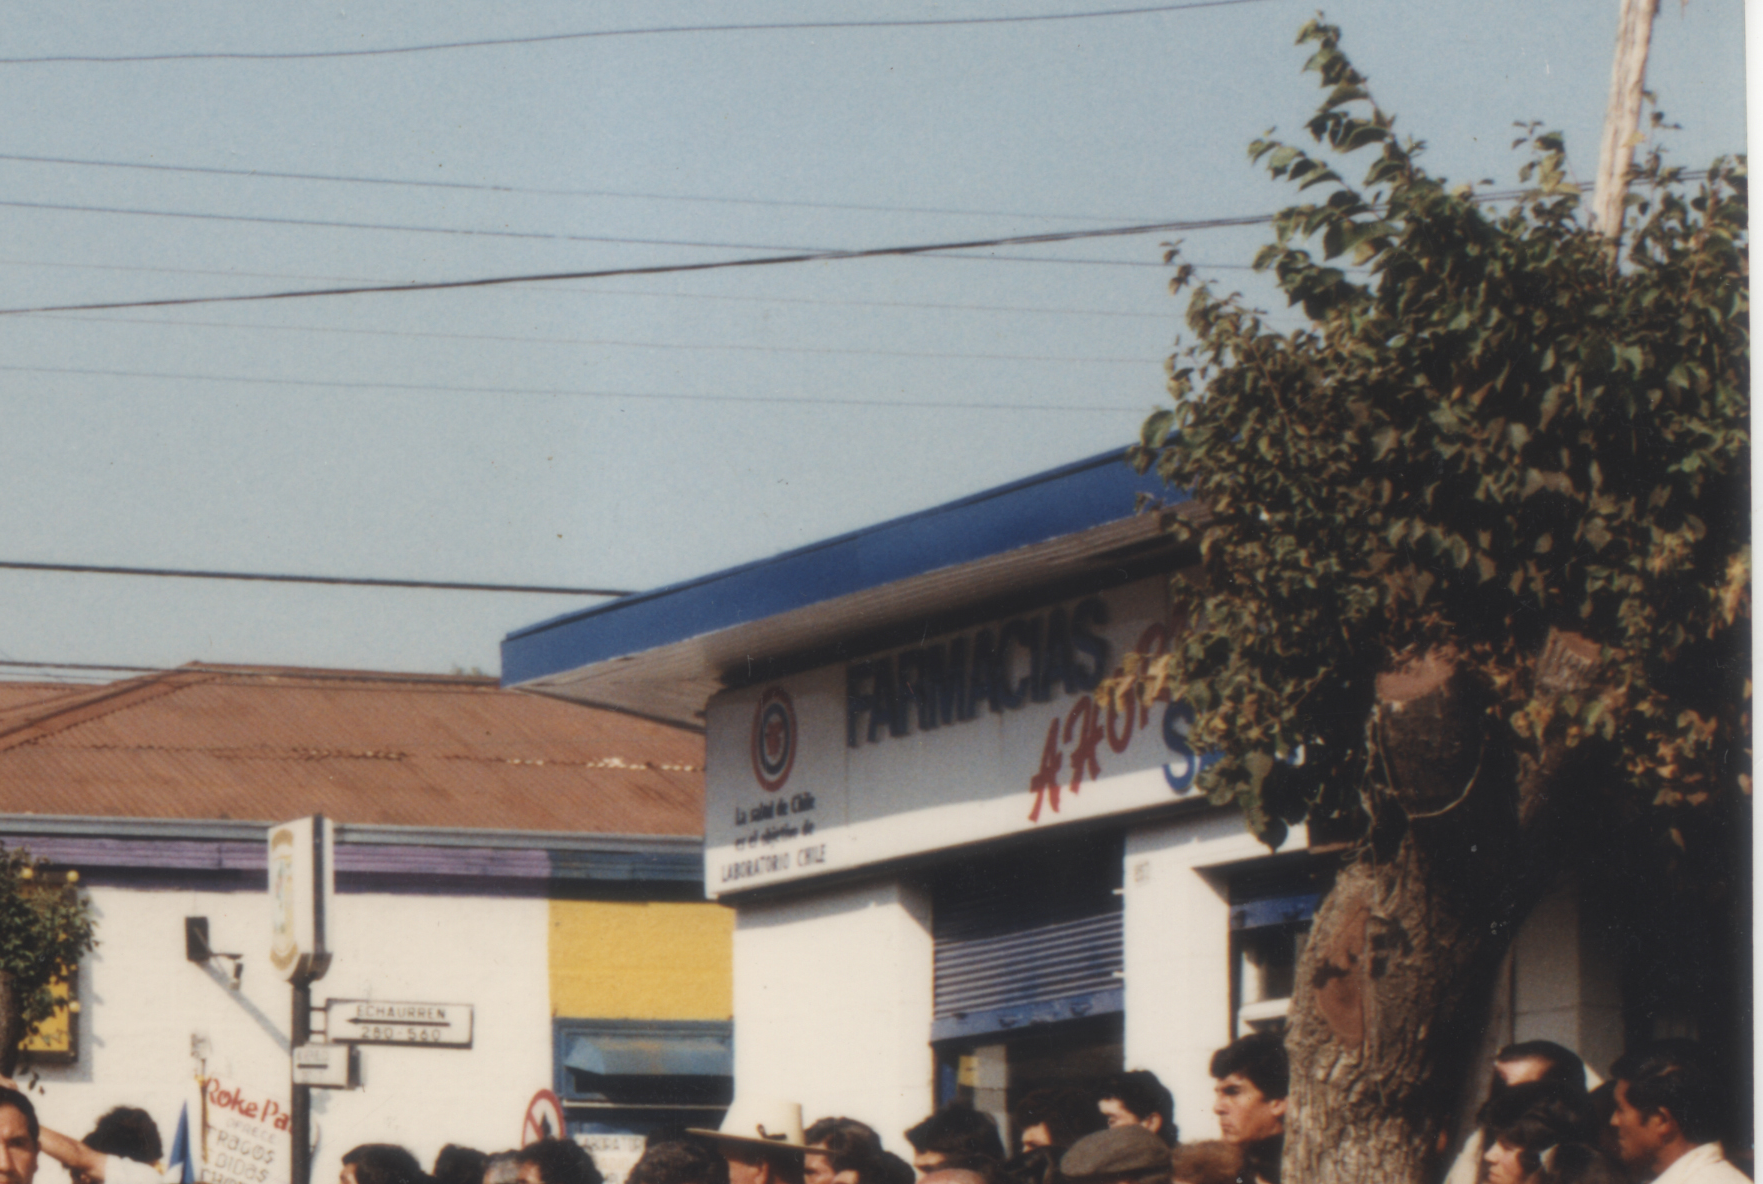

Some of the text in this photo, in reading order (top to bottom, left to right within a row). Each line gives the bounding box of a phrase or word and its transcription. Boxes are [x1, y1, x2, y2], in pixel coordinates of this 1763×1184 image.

[847, 597, 1109, 747] FARMACIAS
[750, 801, 774, 822] salud
[777, 797, 788, 816] de
[791, 791, 816, 813] Chile
[802, 817, 816, 836] de
[721, 844, 826, 883] LABORATORIO CHILE
[356, 1005, 447, 1020] ECHAURREN
[205, 1077, 291, 1133] Roke Pa
